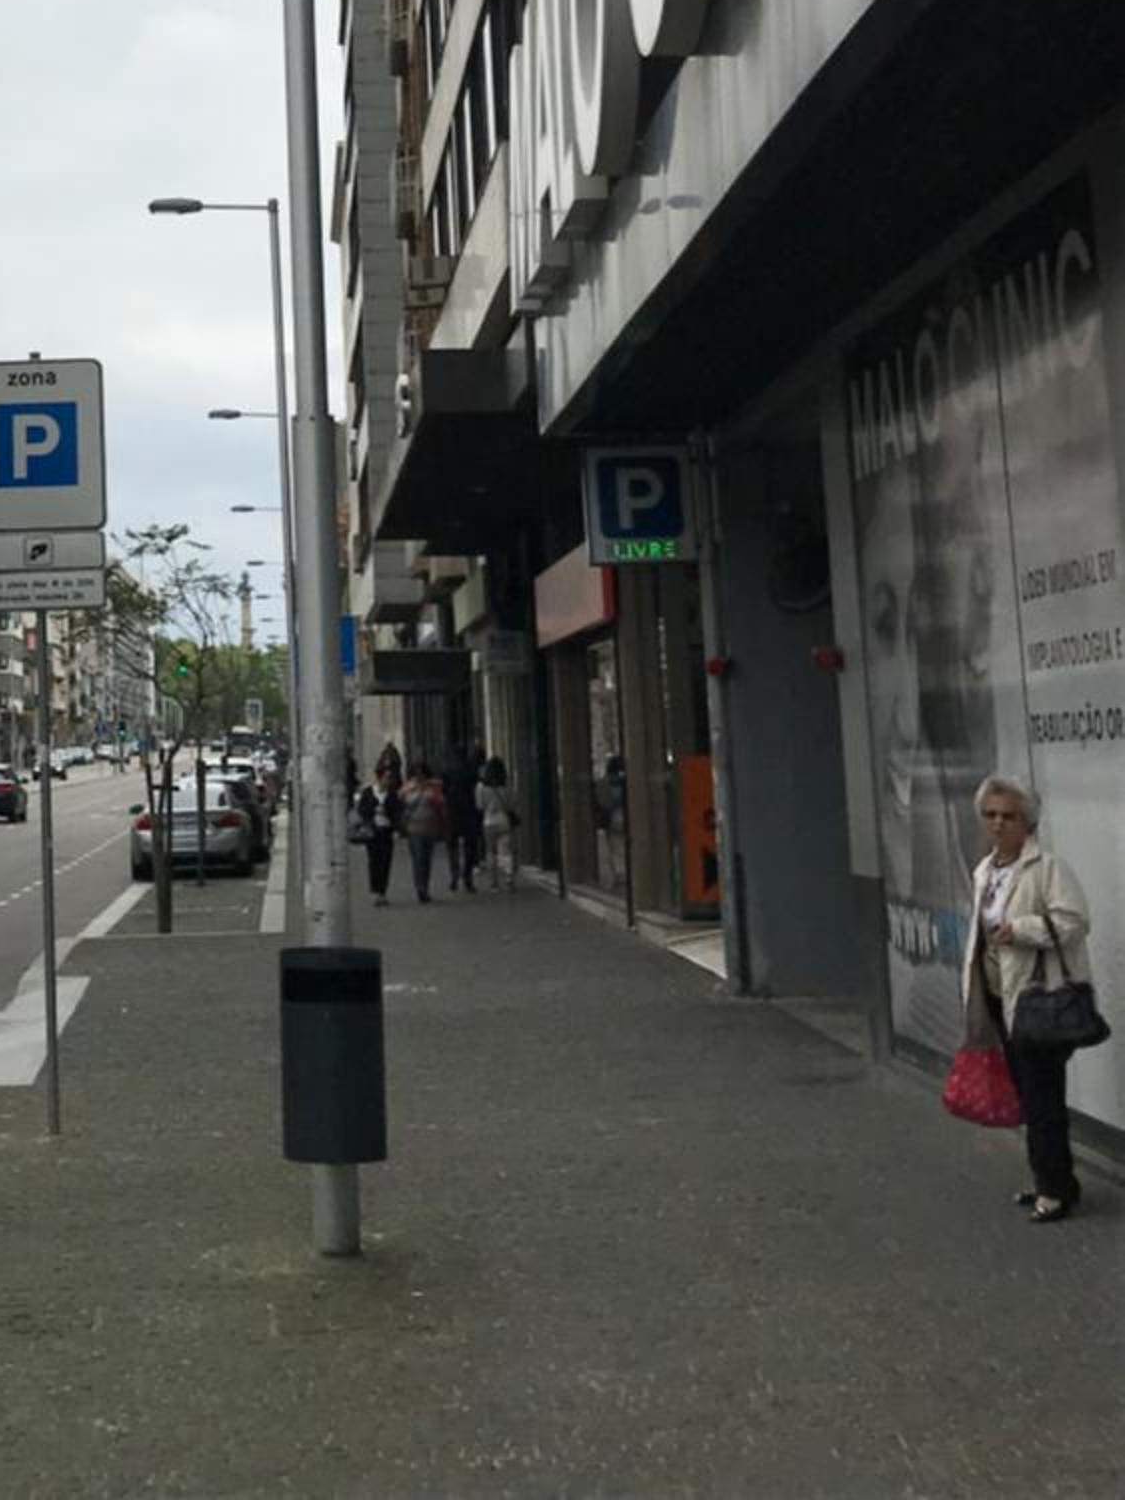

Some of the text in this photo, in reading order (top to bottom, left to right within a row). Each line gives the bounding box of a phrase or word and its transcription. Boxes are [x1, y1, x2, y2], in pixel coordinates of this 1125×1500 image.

[7, 370, 57, 387] zona
[11, 412, 61, 480] P
[616, 467, 666, 530] P
[612, 540, 677, 560] LIVRE
